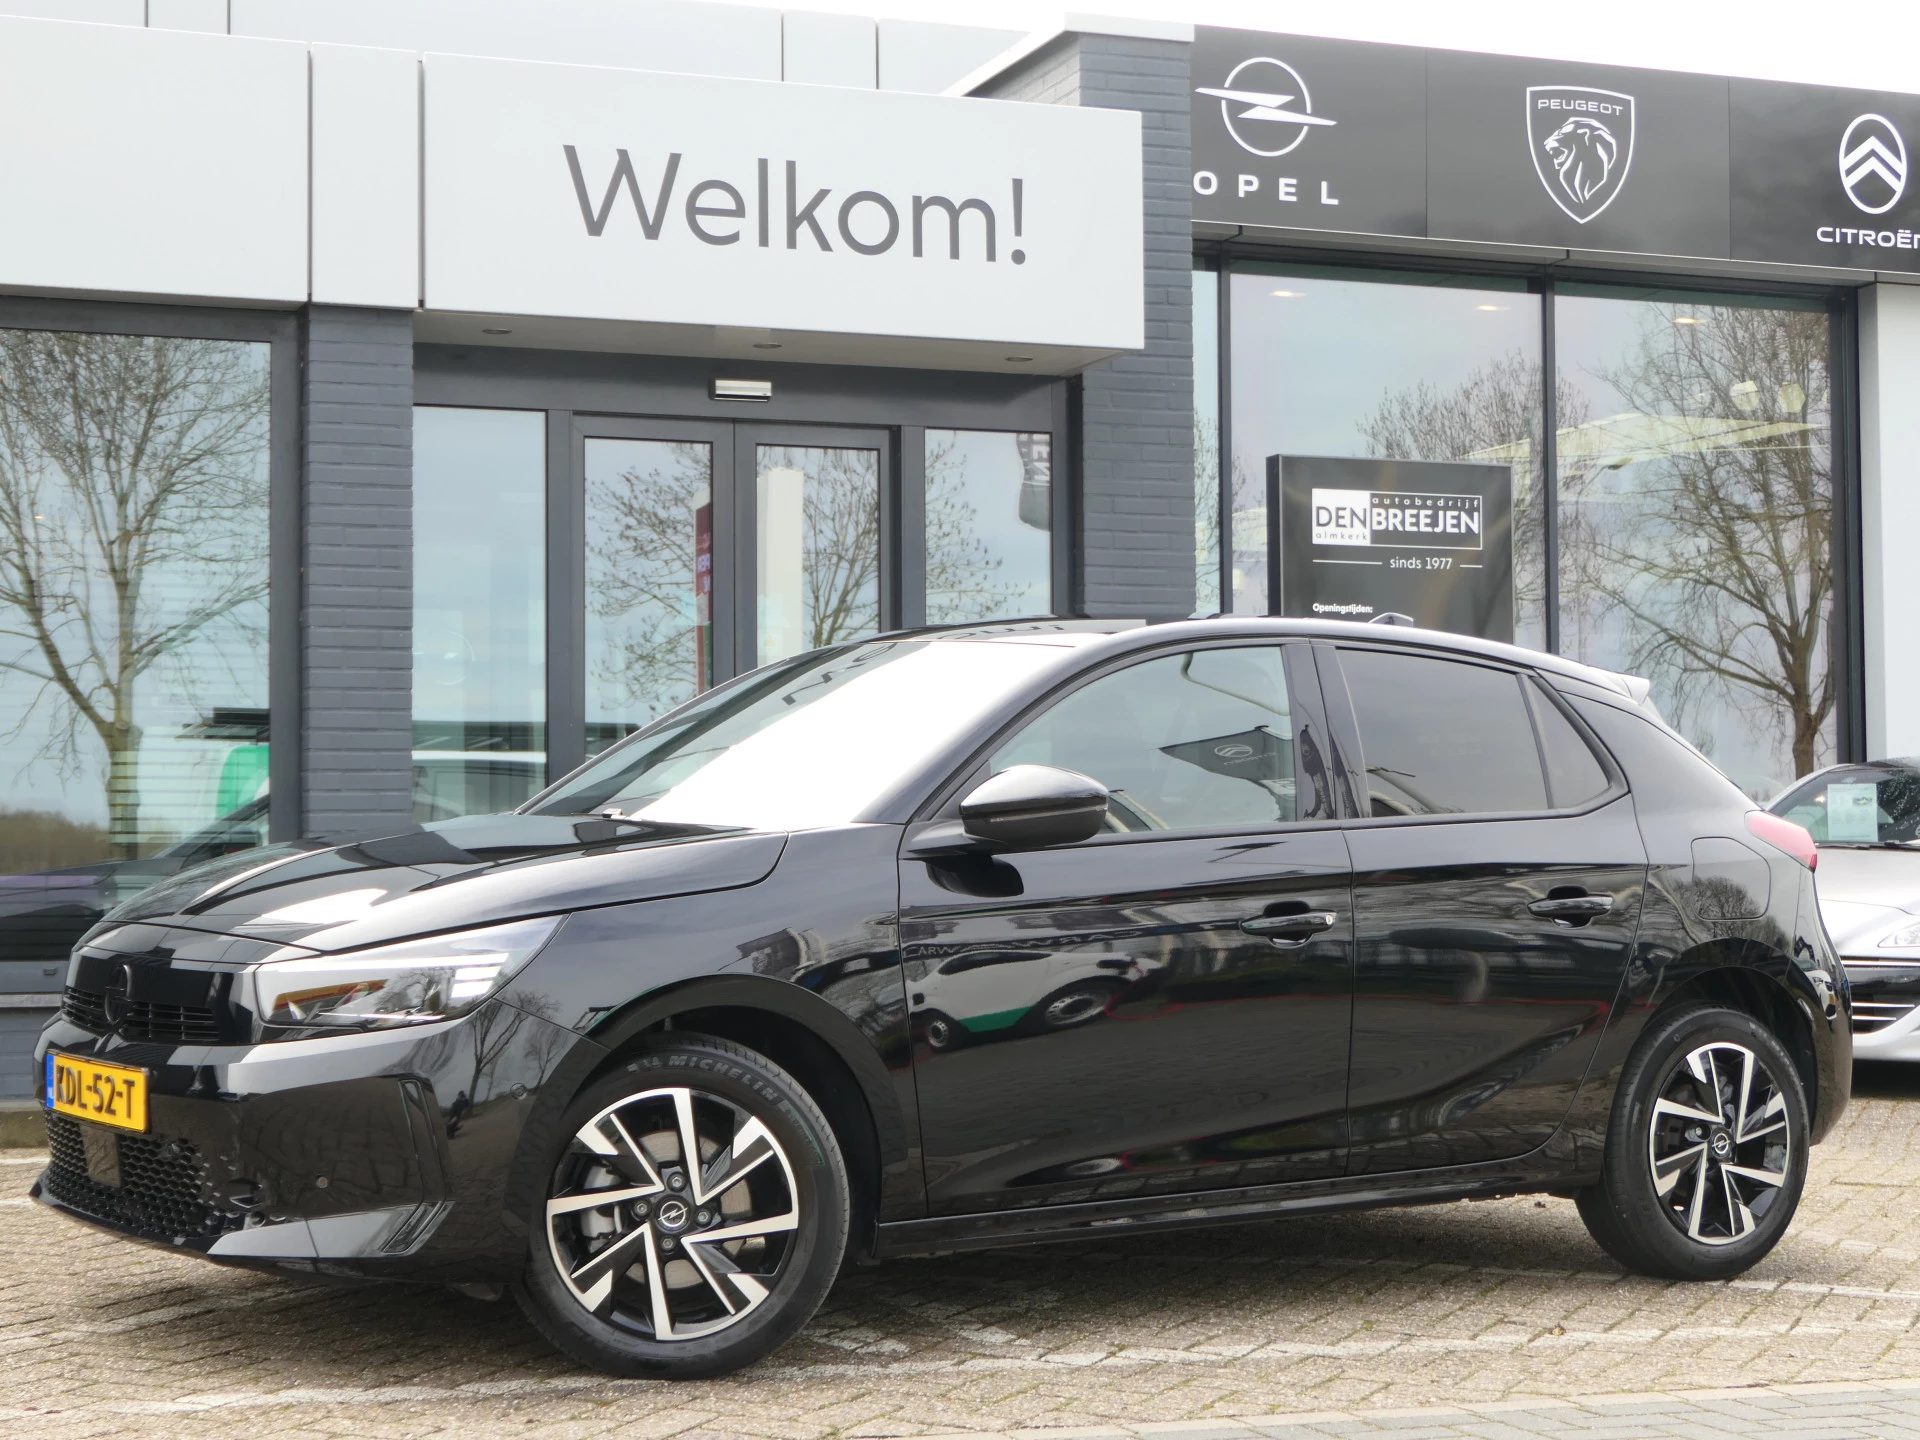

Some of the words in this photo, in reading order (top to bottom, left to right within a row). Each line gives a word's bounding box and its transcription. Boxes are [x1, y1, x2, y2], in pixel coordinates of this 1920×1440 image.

[1537, 98, 1624, 116] PEUGEOT
[1192, 170, 1340, 206] OPEL
[562, 143, 1027, 266] Welkom!
[1371, 496, 1480, 509] autobedrijf
[1315, 506, 1368, 530] DEN
[1371, 507, 1480, 535] BREEJEN
[1315, 531, 1368, 541] almkerk
[1389, 556, 1422, 570] sinds
[1425, 557, 1453, 571] 1977
[1312, 602, 1373, 614] Openingstijden:
[668, 1055, 778, 1101] MICHELIN
[55, 1064, 136, 1120] KDL-52-T
